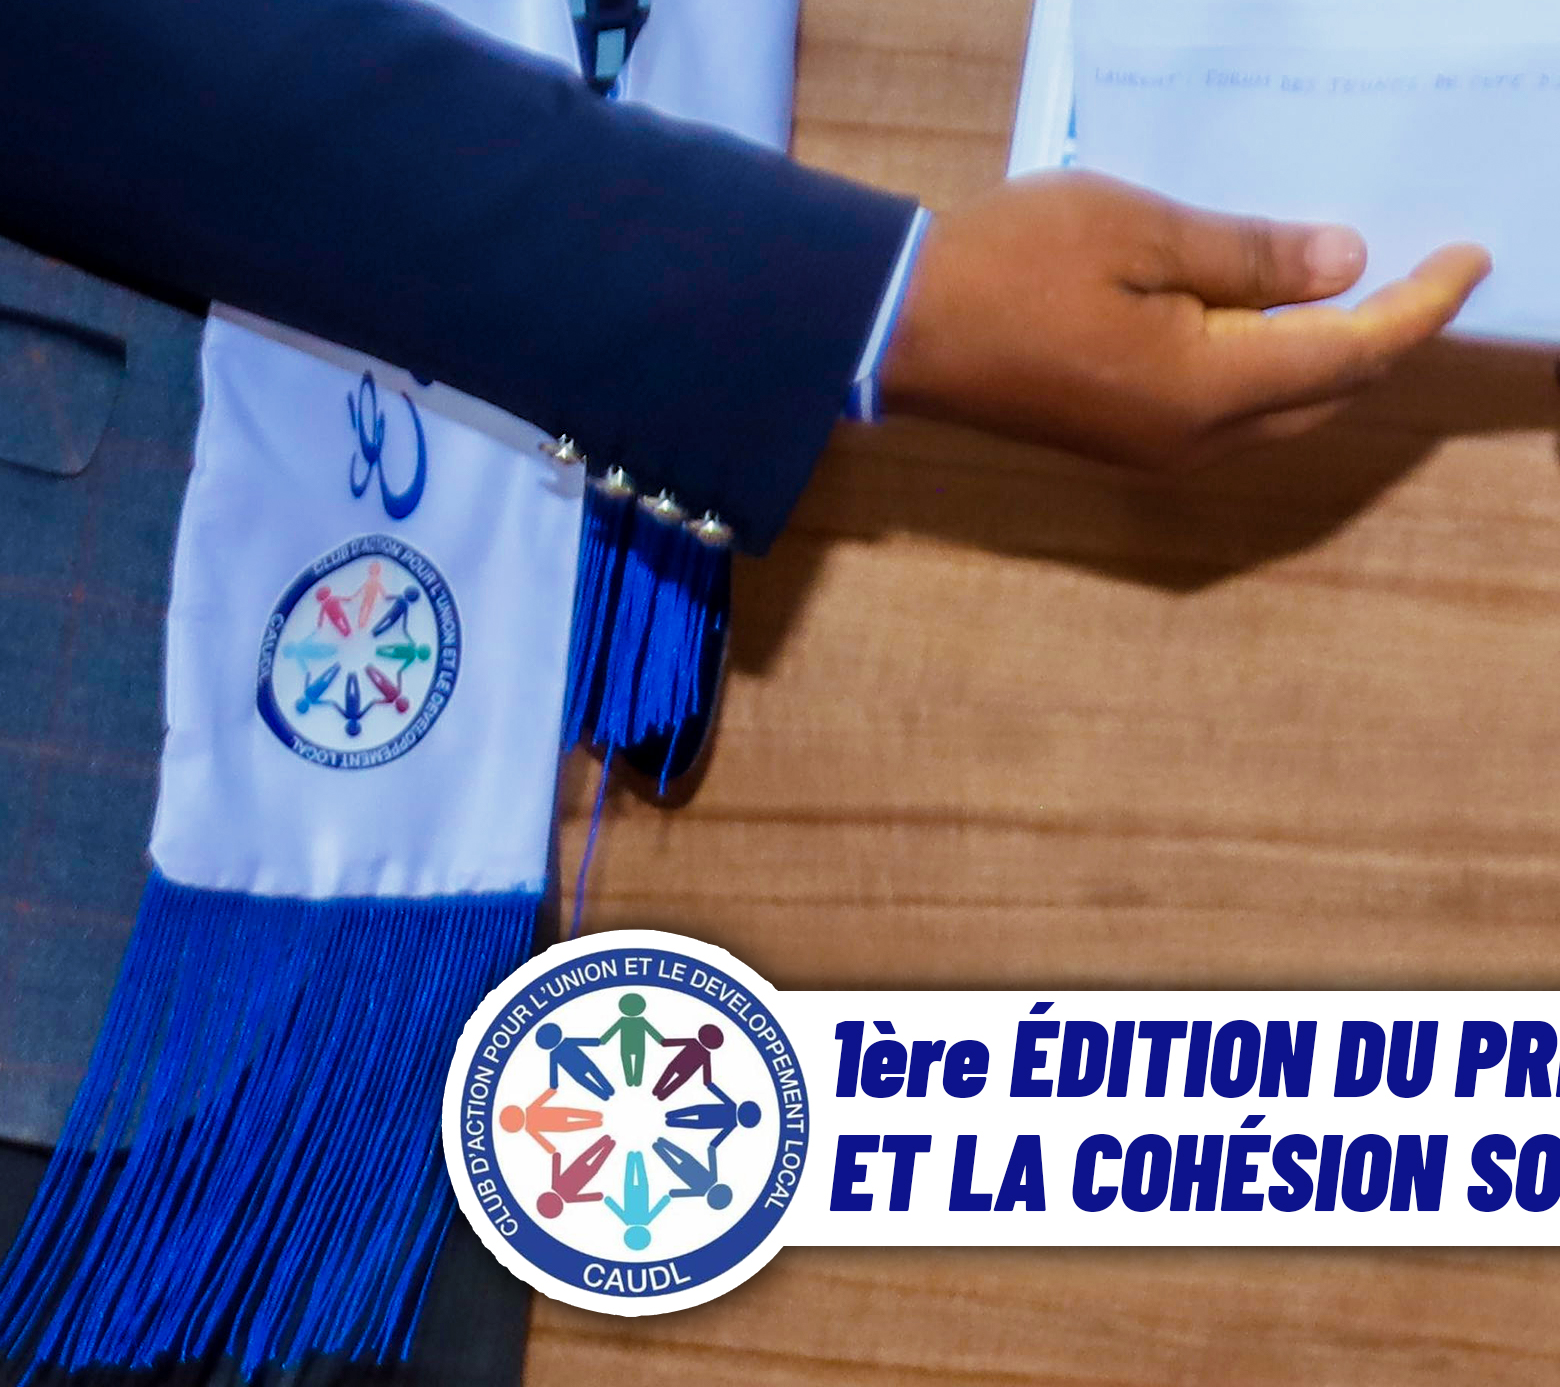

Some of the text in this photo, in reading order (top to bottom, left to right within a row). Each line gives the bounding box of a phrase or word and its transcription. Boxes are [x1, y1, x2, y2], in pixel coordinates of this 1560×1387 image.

[402, 549, 438, 585] POUR
[429, 582, 457, 644] L'UNION
[443, 647, 457, 668] ET
[436, 670, 454, 692] LE
[292, 735, 337, 765] LOCAL
